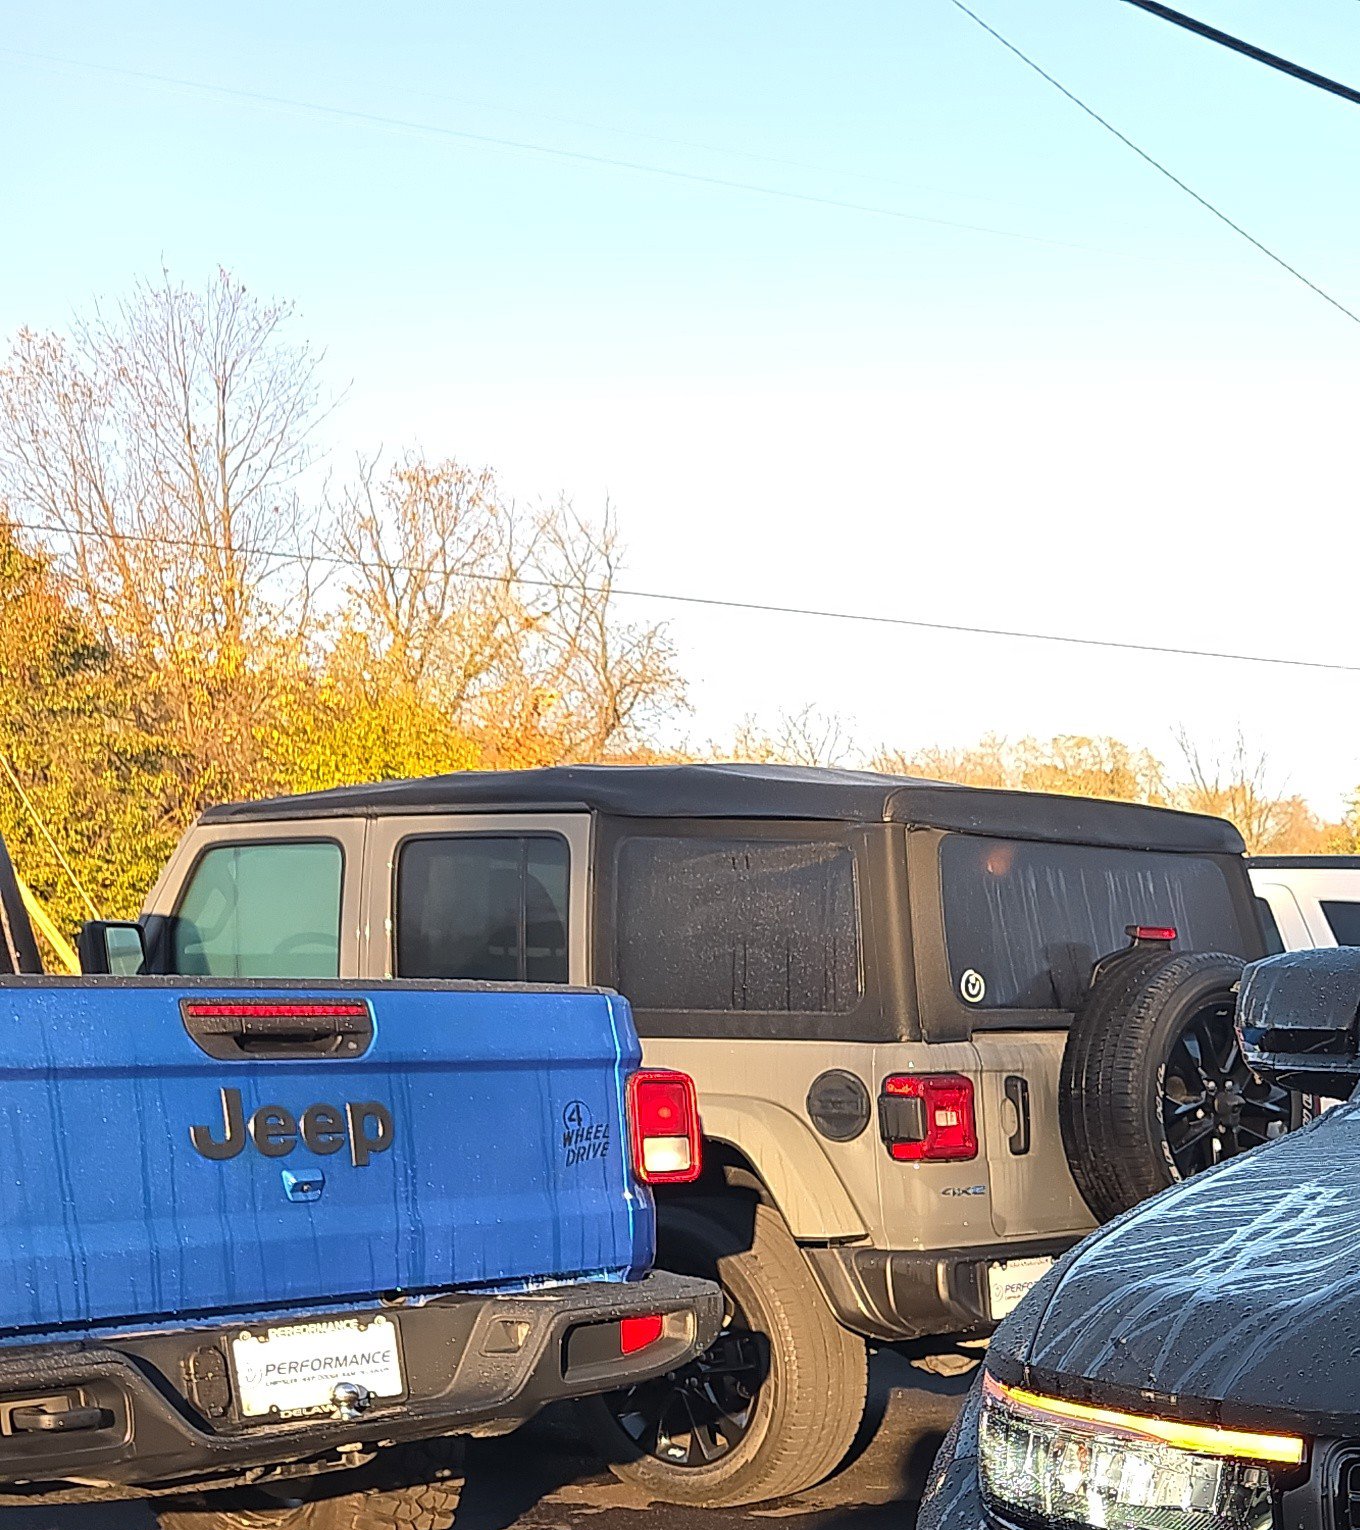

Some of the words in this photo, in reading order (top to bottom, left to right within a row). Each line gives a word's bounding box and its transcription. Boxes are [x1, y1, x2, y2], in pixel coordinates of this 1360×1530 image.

[189, 1086, 395, 1168] Jeep
[567, 1104, 583, 1128] 4
[562, 1123, 610, 1149] WHEEL
[565, 1141, 610, 1167] DRIVE
[264, 1349, 392, 1377] PERFORMANCE
